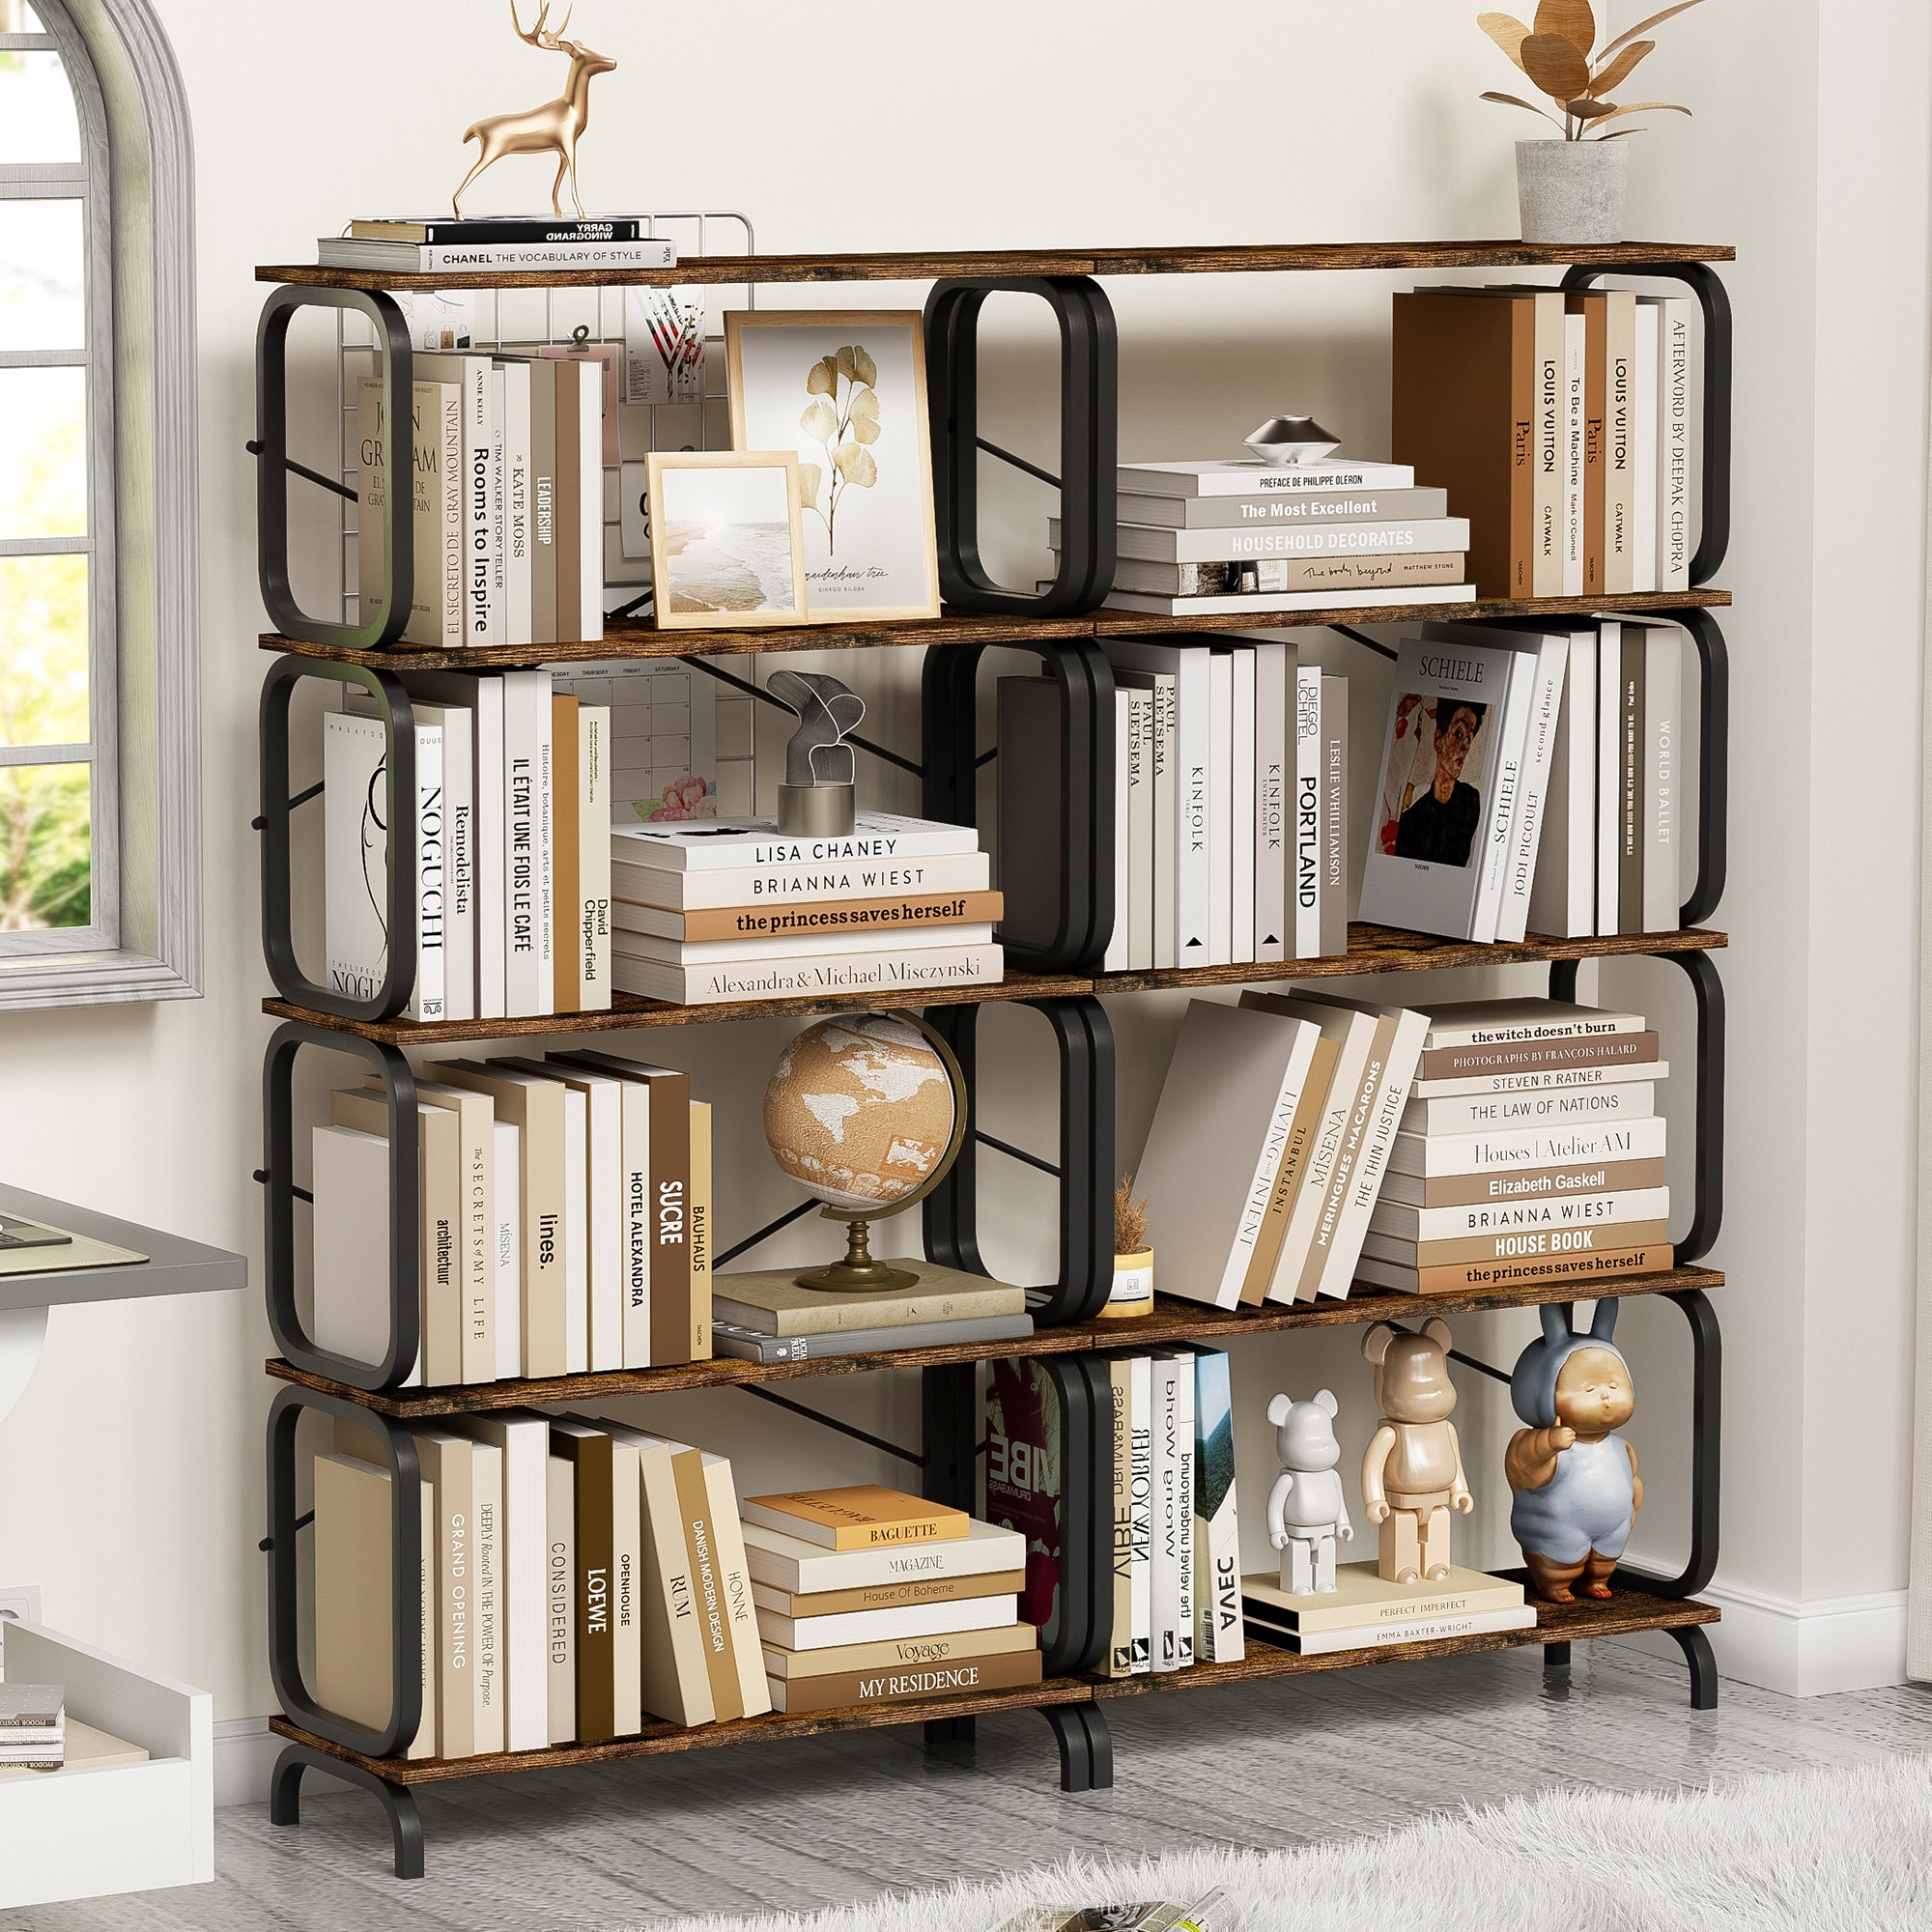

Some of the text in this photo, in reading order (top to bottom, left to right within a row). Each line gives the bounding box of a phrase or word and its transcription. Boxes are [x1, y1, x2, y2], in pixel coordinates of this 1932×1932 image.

[442, 254, 493, 264] CHANEL
[497, 253, 515, 263] THE
[519, 251, 589, 262] VOCABULARY
[593, 251, 608, 261] OF
[610, 251, 641, 261] STYLE
[1544, 360, 1555, 472] LOUIS VUITTON
[1615, 357, 1627, 469] LOUIS VUITTON
[1516, 420, 1530, 467] Paris
[1587, 417, 1602, 464] Paris
[1670, 320, 1686, 574] AFTERWORD BY DEEPAK CHOPRA
[445, 400, 459, 634] EL SECRETO DE GRAY MOUNTAIN
[495, 515, 503, 550] STORY
[513, 468, 525, 558] KATE MOSS
[537, 476, 552, 545] LEADERSHIP
[1240, 499, 1378, 519] The Most Excellent
[1544, 505, 1552, 556] CATWALK
[1615, 502, 1624, 554] CATWALK
[470, 448, 491, 632] Rooms to Inspire
[1232, 530, 1414, 553] HOUSEHOLD DECORATES
[495, 553, 503, 588] TELLER
[1303, 566, 1325, 579] The
[1419, 656, 1485, 683] SCHIELE
[1143, 701, 1152, 746] PAUL
[1155, 686, 1164, 777] SIETSEMA
[1166, 686, 1175, 733] PAUL
[1298, 678, 1308, 746] UCHITEL
[1308, 687, 1319, 736] DIEGO
[1536, 679, 1553, 763] second glance
[1130, 700, 1141, 787] SIETSEMA
[1268, 764, 1280, 849] KINFOLK
[1494, 760, 1518, 844] SCHIELE
[1659, 720, 1670, 844] WORLD BALLET
[1192, 767, 1204, 852] KINFOLK
[420, 785, 443, 951] NOGUCHI
[455, 806, 470, 916] Remodelista
[513, 758, 534, 952] IL ÉTAIT UNE FOIS LE CAFÉ
[755, 839, 897, 863] LISA CHANEY
[1299, 777, 1317, 908] PORTLAND
[1514, 791, 1539, 896] JODI PICOULT
[753, 869, 924, 895] BRIANNA WIEST
[582, 899, 597, 980] Chipperfield
[597, 899, 609, 936] David
[736, 899, 966, 933] the princess saves herself
[706, 957, 980, 995] Alexandra & Michael Misczynski
[1453, 1043, 1637, 1068] PHOTOGRAPHS BY FRANÇOIS HALARD
[1472, 1032, 1493, 1043] the
[1494, 1028, 1532, 1040] witch
[1585, 1022, 1616, 1034] burn
[1492, 1070, 1603, 1090] STEVEN R RATNER
[1470, 1094, 1619, 1120] THE LAW OF NATIONS
[1272, 1127, 1307, 1214] INSTANBUL
[1317, 1060, 1381, 1247] MERINGUES MACARONS
[1354, 1085, 1403, 1208] THE THIN JUSTICE
[1475, 1131, 1632, 1163] Houses Atelier AM
[1490, 1170, 1605, 1196] Elizabeth Gaskell
[660, 1180, 683, 1245] SUCRE
[1468, 1201, 1614, 1229] BRIANNA WIEST
[540, 1214, 558, 1270] lines.
[631, 1171, 643, 1308] HOTEL ALEXANDRA
[693, 1206, 705, 1272] BAUHAUS
[1495, 1230, 1594, 1257] HOUSE BOOK
[1466, 1253, 1645, 1283] the princess saves herself
[870, 1522, 937, 1543] BAGUETTE
[621, 1553, 630, 1627] OPENHOUSE
[692, 1520, 724, 1653] DANISH MODERN DESIGN
[889, 1555, 945, 1574] MAGAZINE
[452, 1514, 466, 1669] GRAND OPENING
[552, 1542, 566, 1664] CONSIDERED
[587, 1568, 607, 1634] LOEWE
[670, 1574, 692, 1620] RUM
[728, 1571, 749, 1623] HONNE
[864, 1583, 954, 1603] House Of Boheme
[1379, 1600, 1467, 1617] PERFECT IMPERFECT
[1377, 1622, 1473, 1641] EMMA BAXTER-WRIGHT
[859, 1666, 980, 1698] MY RESIDENCE
